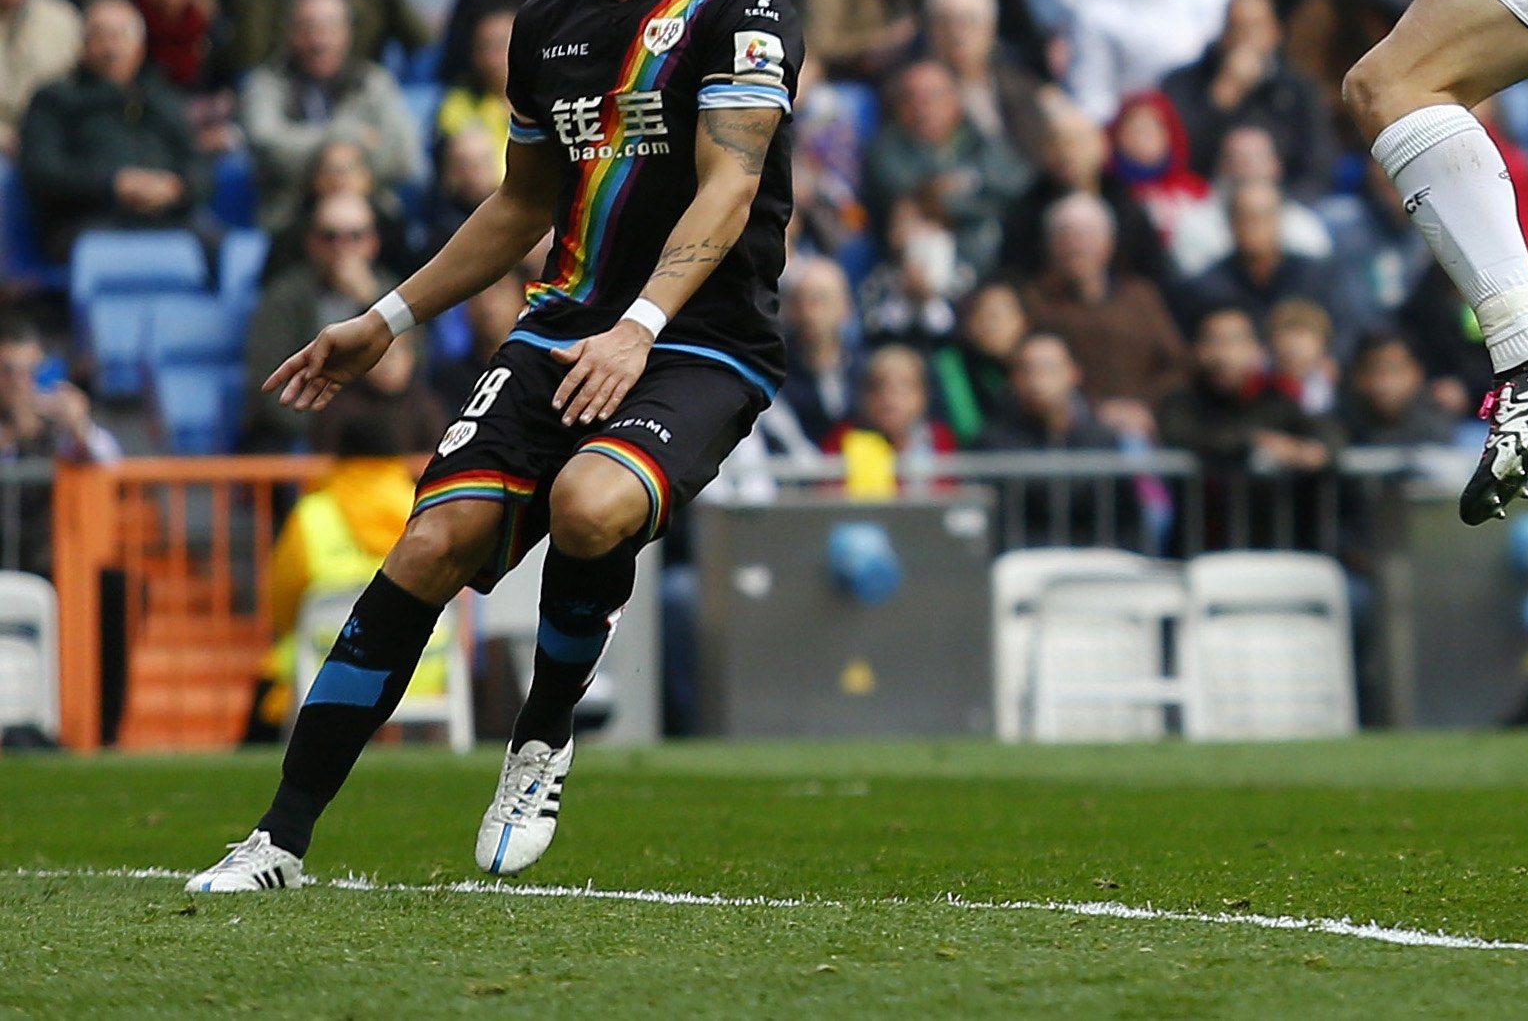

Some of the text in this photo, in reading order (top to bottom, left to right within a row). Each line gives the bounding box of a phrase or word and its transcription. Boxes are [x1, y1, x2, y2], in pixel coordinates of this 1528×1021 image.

[744, 8, 780, 22] KELME
[542, 42, 590, 60] KELME
[568, 139, 671, 163] bao.com
